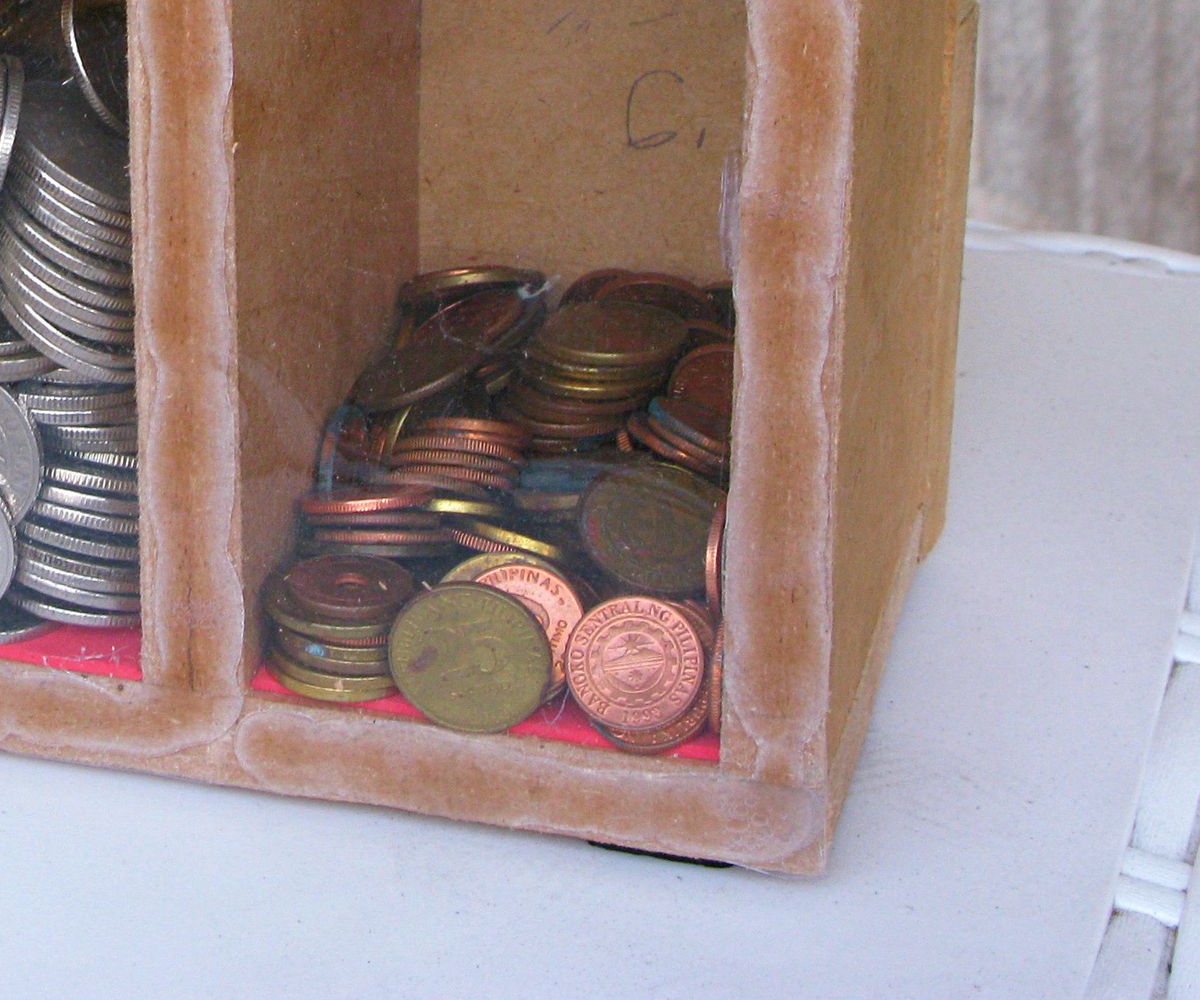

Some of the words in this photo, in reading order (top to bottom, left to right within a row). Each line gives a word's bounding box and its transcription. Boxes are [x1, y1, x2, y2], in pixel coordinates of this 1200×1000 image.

[484, 567, 562, 598] ILIPINAS
[574, 600, 645, 647] SENTRAL
[648, 605, 674, 623] NG
[569, 653, 611, 716] BANGKO
[668, 622, 700, 707] PILIPINAS
